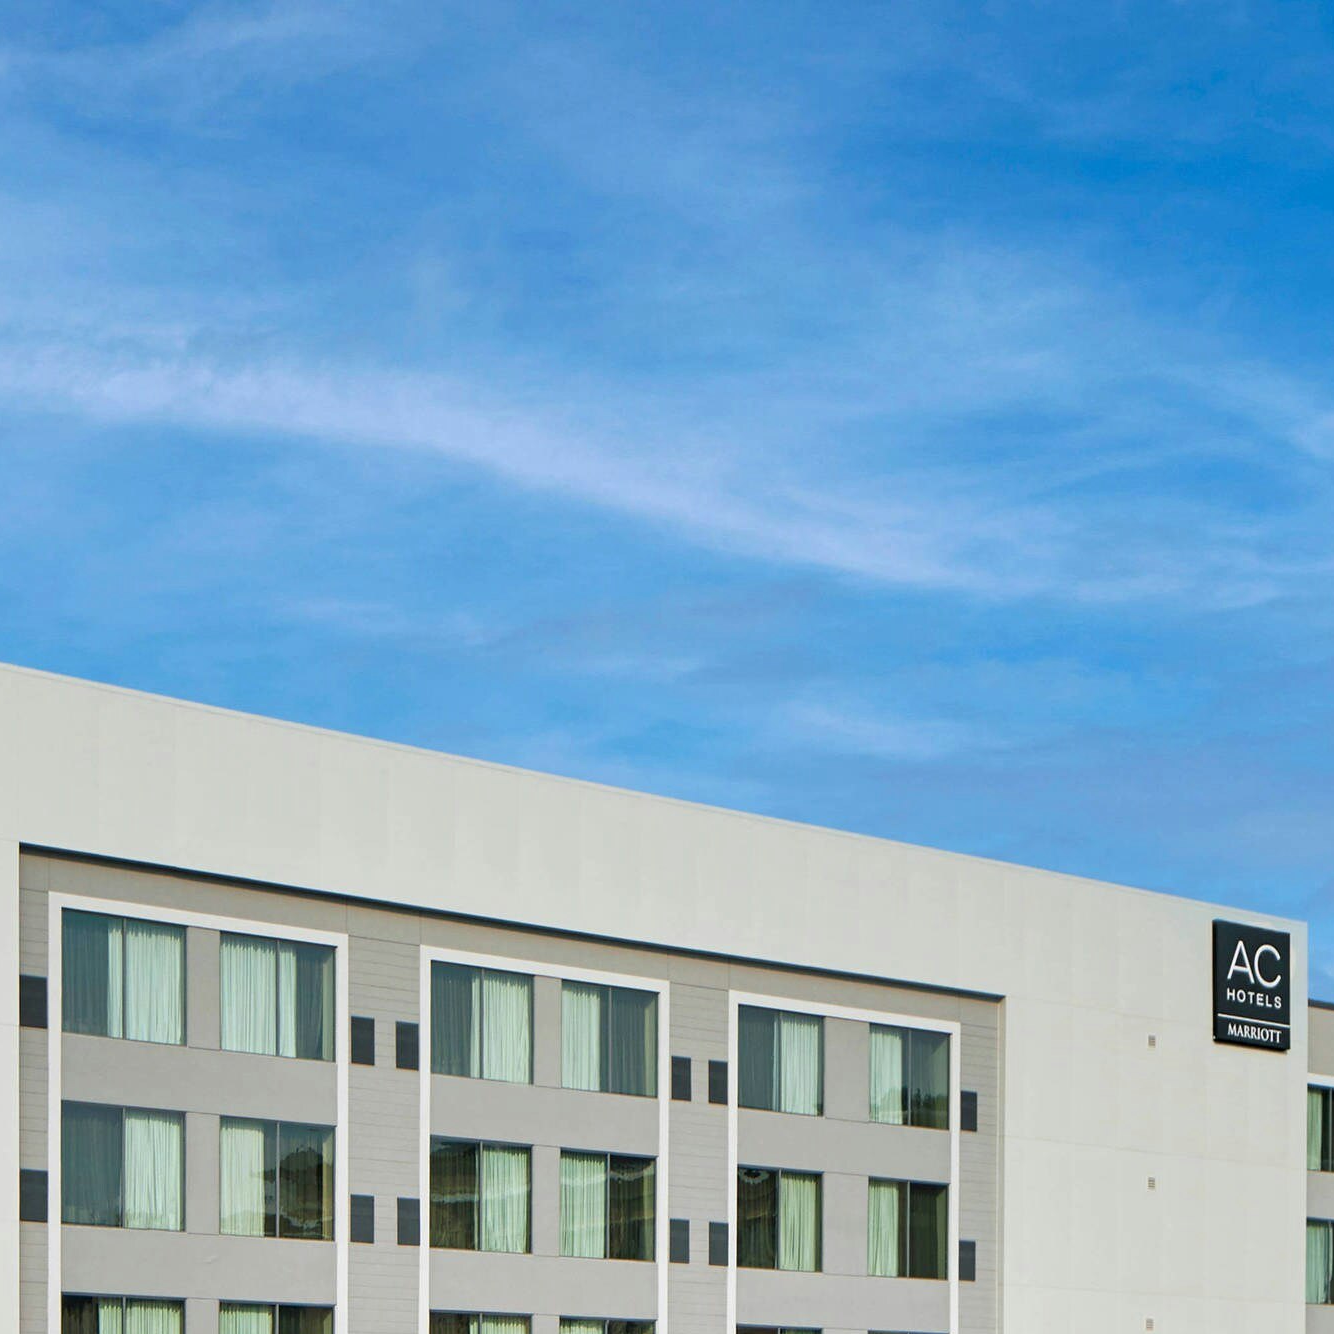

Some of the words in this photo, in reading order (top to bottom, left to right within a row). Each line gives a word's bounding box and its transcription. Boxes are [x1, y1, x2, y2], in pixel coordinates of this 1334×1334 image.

[1227, 940, 1281, 988] AC
[1226, 988, 1282, 1009] HOTELS
[1227, 1023, 1282, 1044] MARRIOTT
